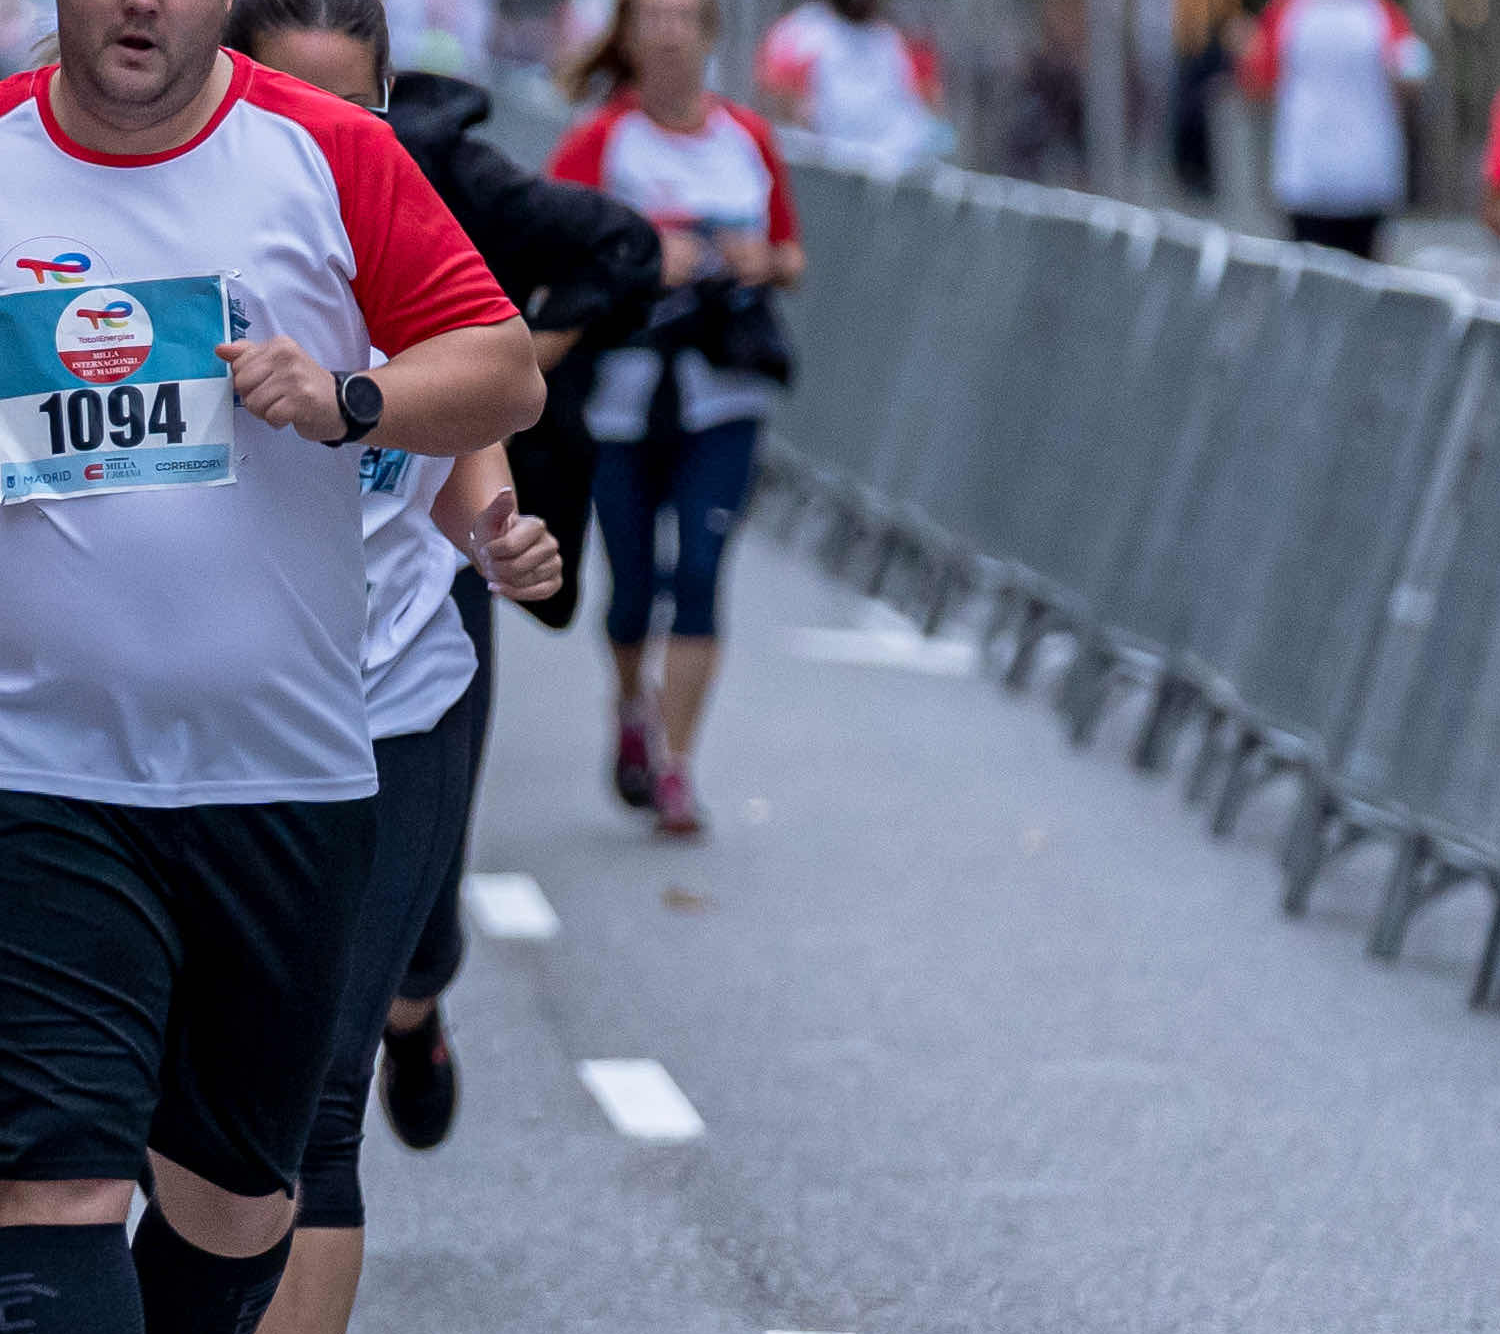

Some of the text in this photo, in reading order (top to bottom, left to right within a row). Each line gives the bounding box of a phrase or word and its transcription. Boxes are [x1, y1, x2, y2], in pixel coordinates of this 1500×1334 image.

[92, 351, 119, 359] MILLA
[82, 365, 130, 377] DE MADRID
[39, 382, 187, 455] 1094
[23, 470, 71, 485] MADRID
